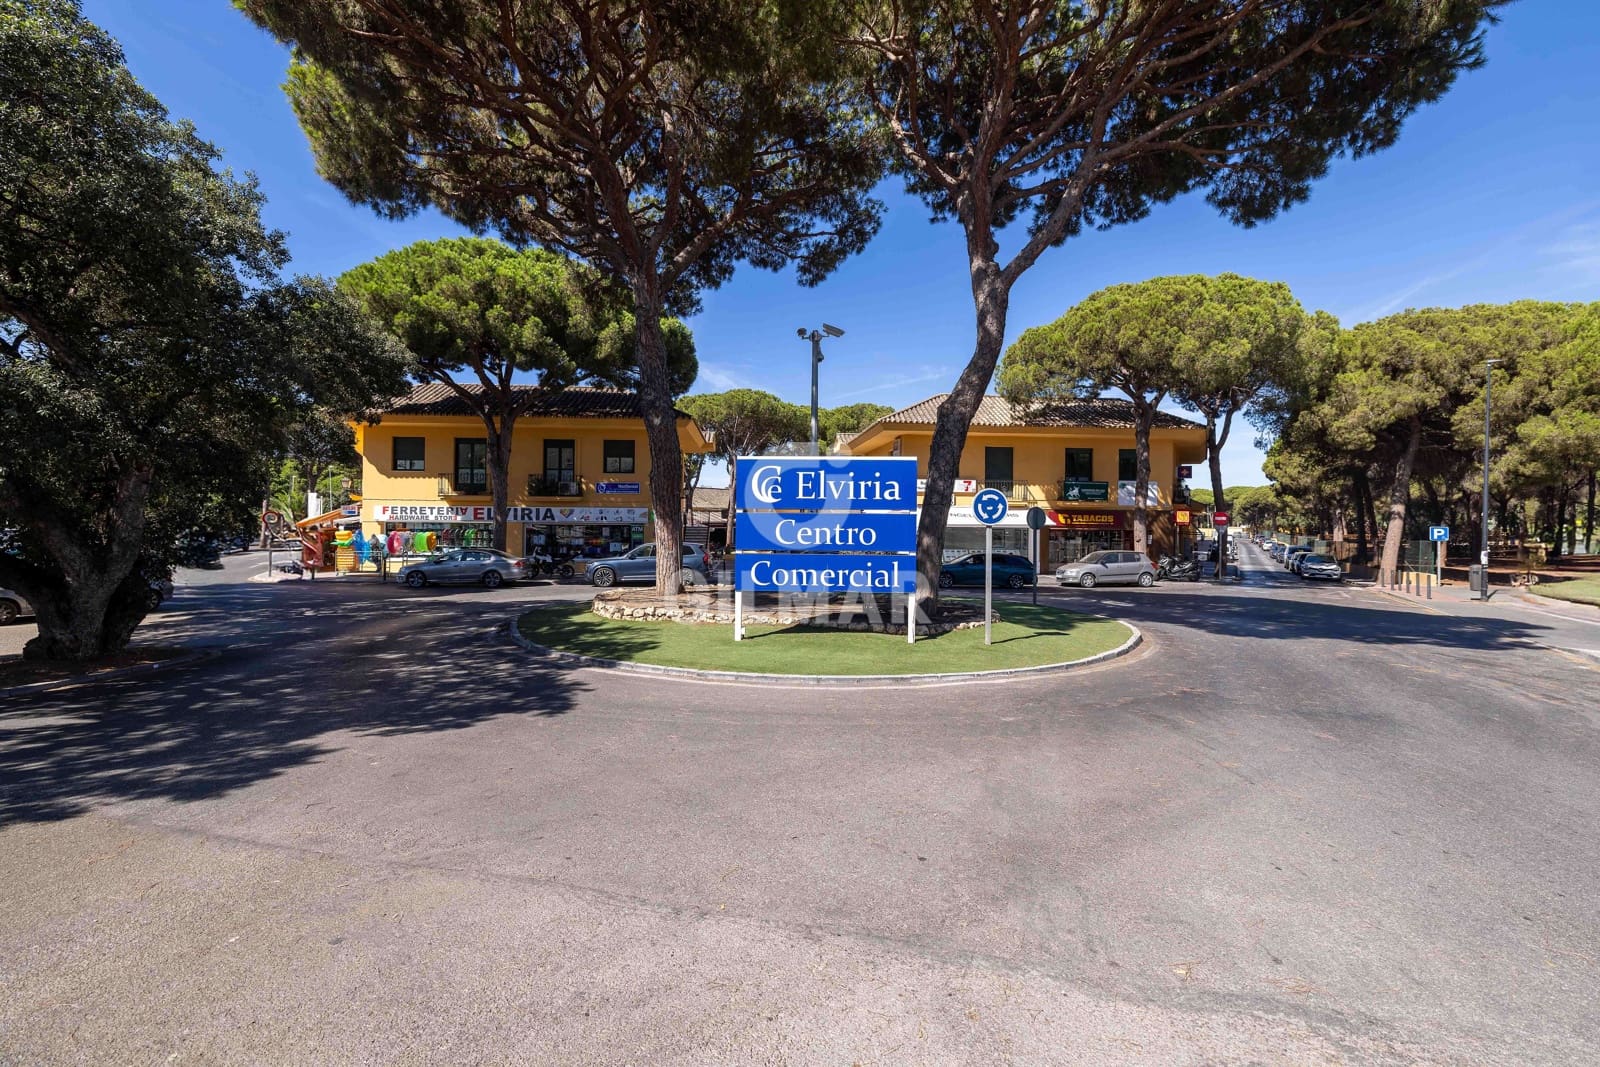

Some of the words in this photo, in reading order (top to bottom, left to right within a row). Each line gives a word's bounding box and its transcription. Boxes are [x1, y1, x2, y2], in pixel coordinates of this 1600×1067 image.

[796, 470, 901, 500] Elviria
[1071, 514, 1114, 523] TABACOS
[775, 519, 877, 546] Centro
[1433, 528, 1445, 540] P
[750, 560, 901, 588] Comercial
